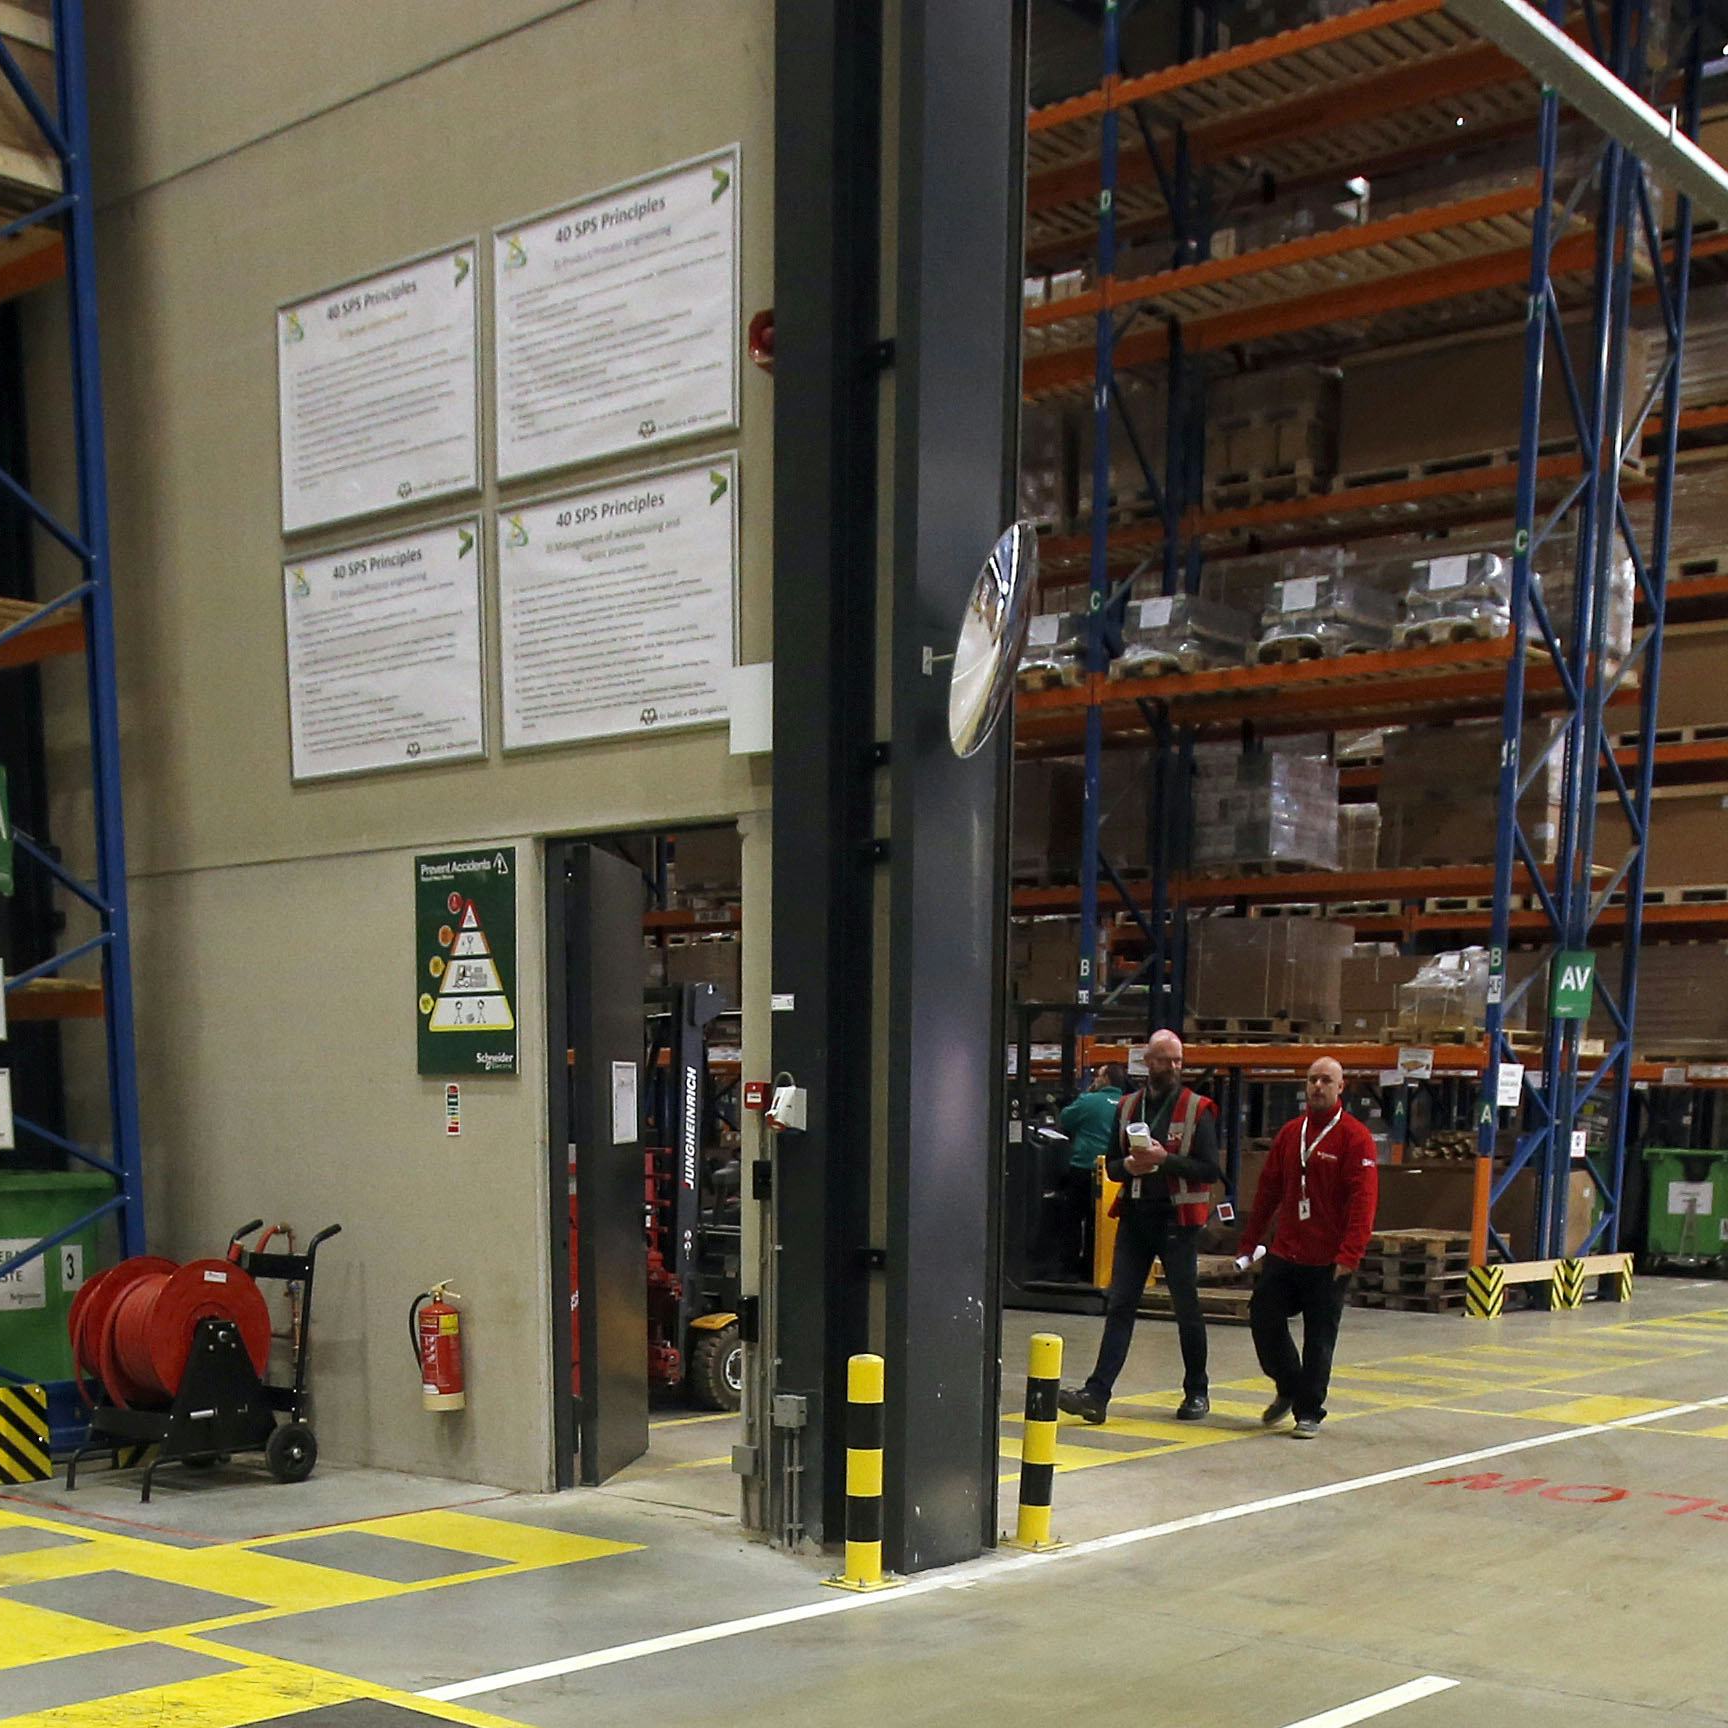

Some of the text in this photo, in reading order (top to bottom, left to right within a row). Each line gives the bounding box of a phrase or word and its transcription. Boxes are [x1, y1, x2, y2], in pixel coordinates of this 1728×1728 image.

[556, 197, 665, 243] 40 SPS Principles
[364, 280, 416, 307] Principles
[556, 492, 665, 528] 40 SPS Principles
[1515, 530, 1528, 551] C
[333, 549, 421, 579] 40 SPS Principles
[421, 858, 491, 876] Prevent Accidents
[1080, 959, 1090, 977] B
[1491, 948, 1501, 967] B
[1560, 964, 1591, 992] AV
[476, 1051, 514, 1064] Schneider
[1481, 1104, 1492, 1124] A
[685, 1066, 697, 1190] JUNGHEINRICH
[65, 1253, 75, 1280] 3
